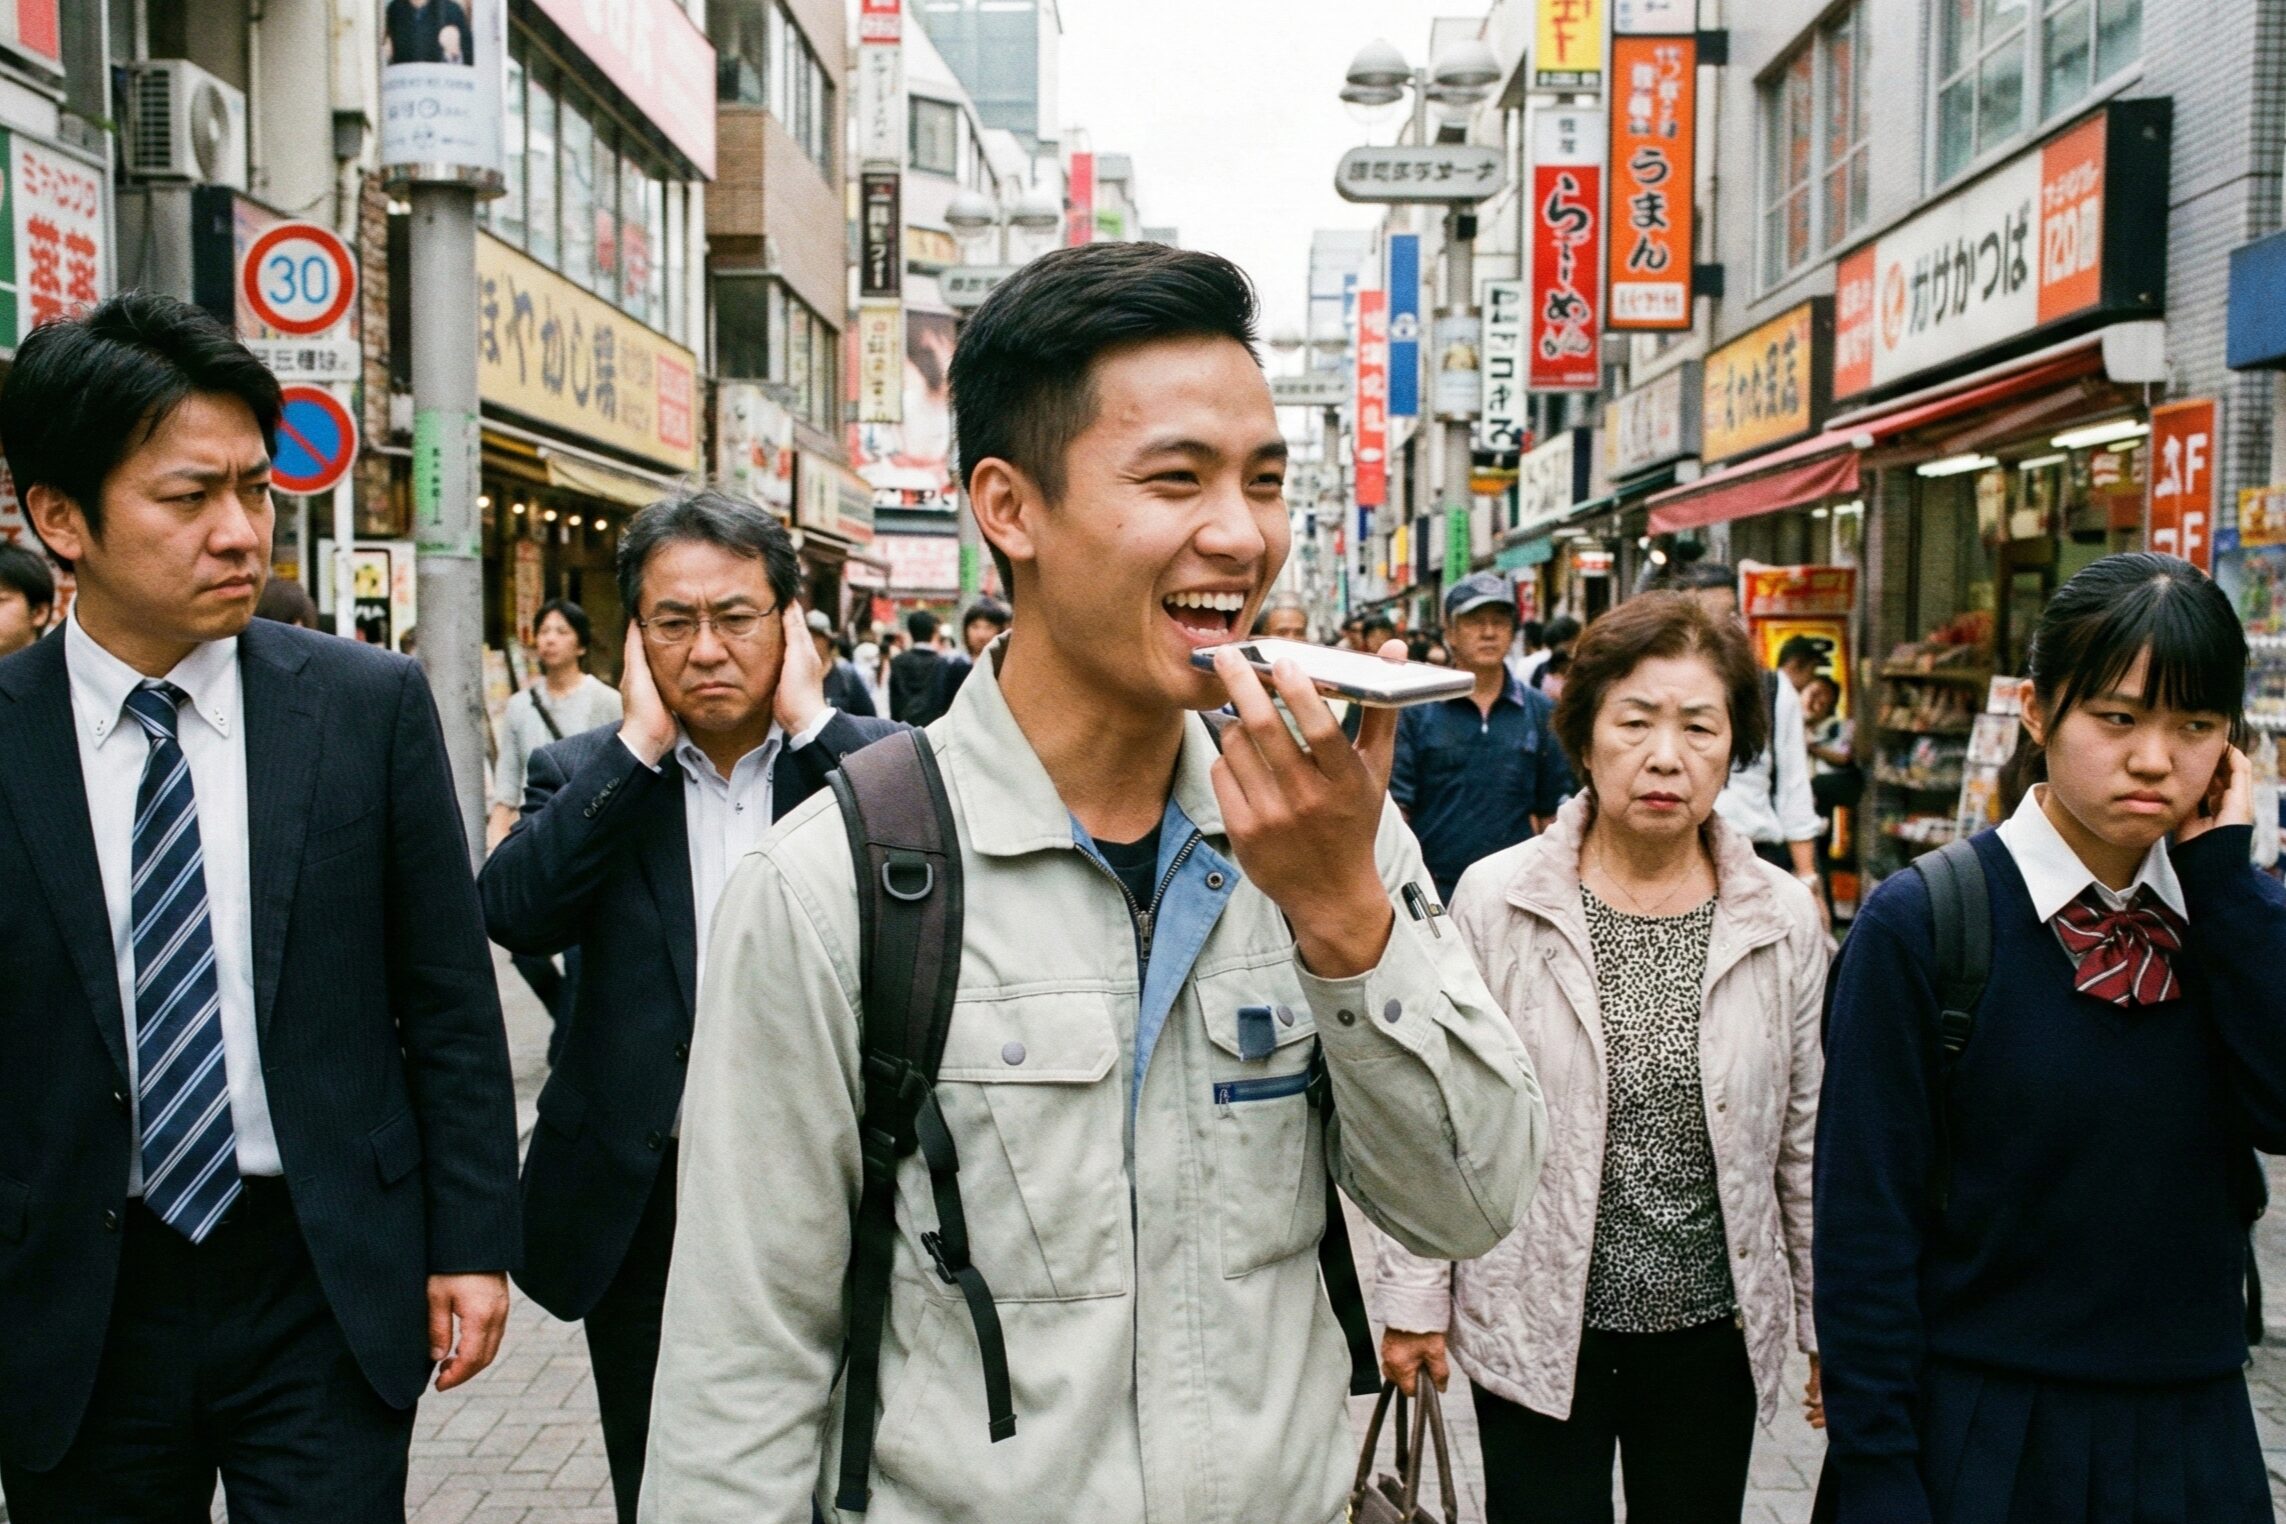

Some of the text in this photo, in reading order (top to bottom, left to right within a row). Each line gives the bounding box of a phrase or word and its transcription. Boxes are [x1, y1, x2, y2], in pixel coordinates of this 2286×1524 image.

[1627, 146, 1670, 272] うまん
[269, 255, 330, 304] 30
